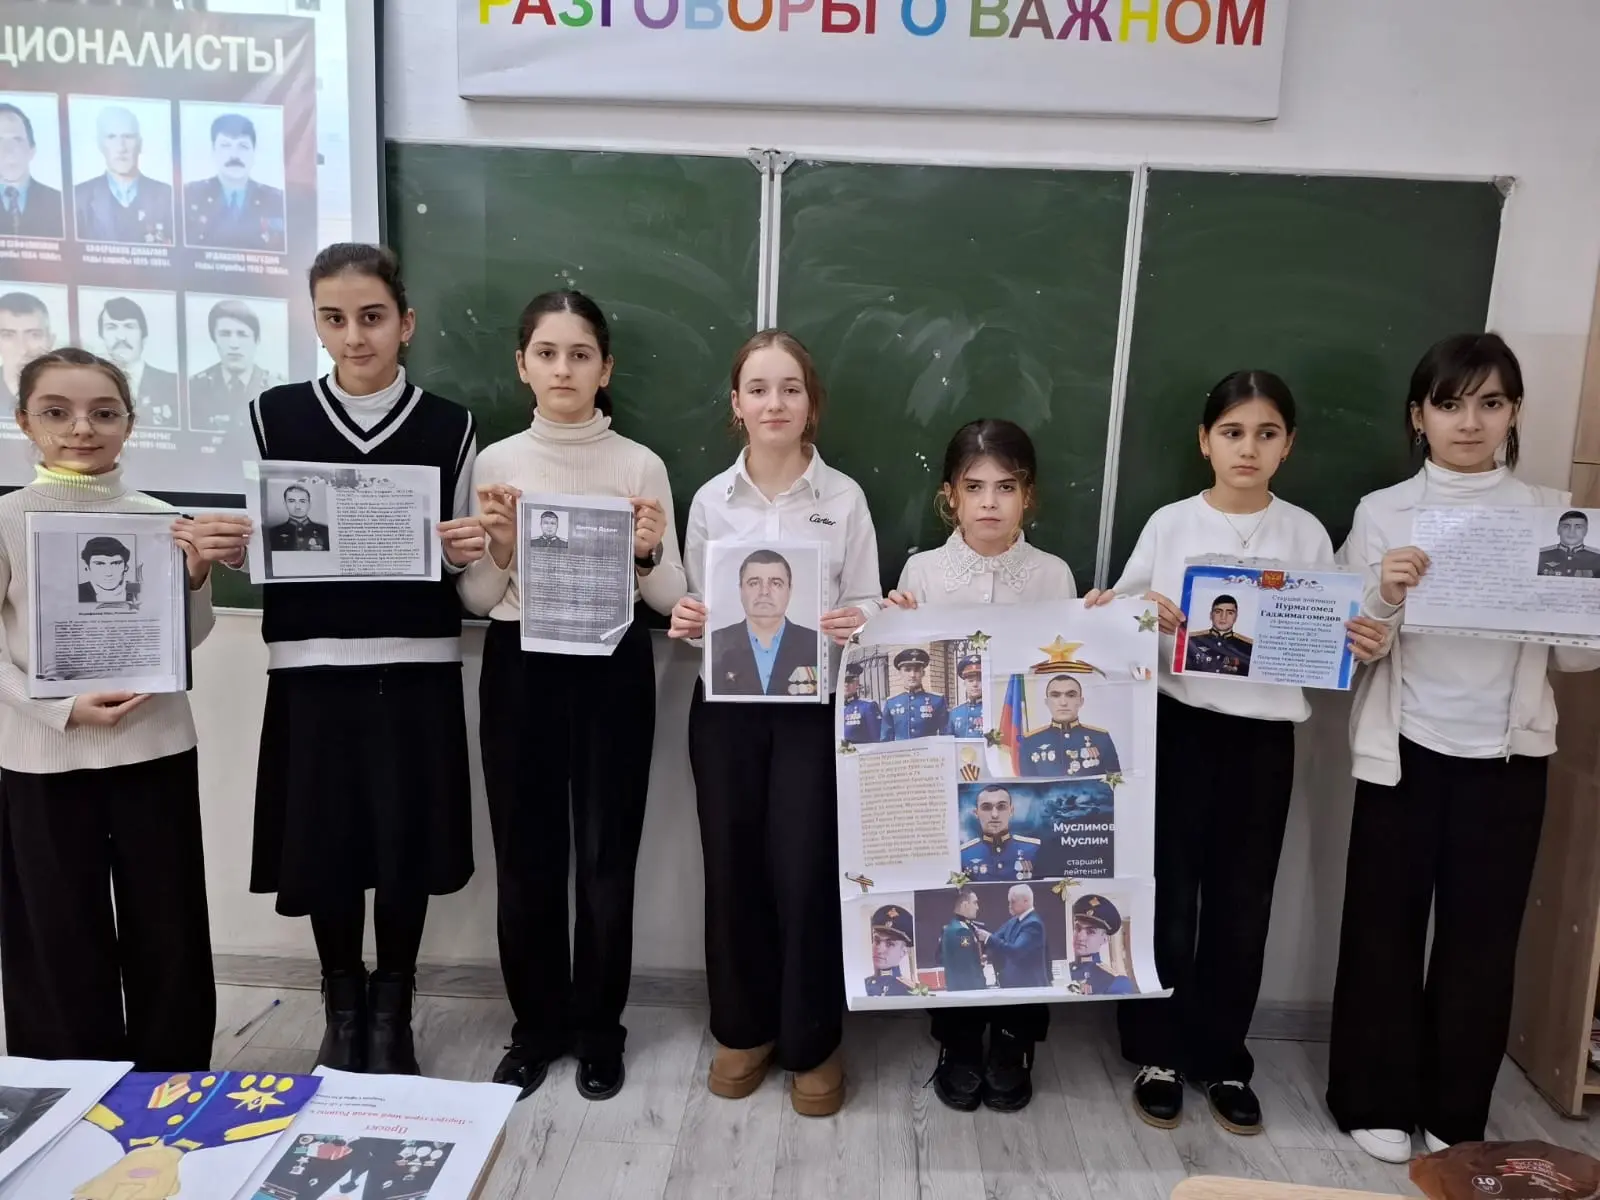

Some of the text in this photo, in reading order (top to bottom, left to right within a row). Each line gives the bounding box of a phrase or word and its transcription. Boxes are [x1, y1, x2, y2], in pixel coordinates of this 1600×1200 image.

[901, 0, 947, 37] О
[969, 0, 1265, 46] ВАЖНОМ
[809, 513, 836, 526] Cartier
[1275, 602, 1334, 613] Нурмагомед
[1260, 610, 1342, 622] Гаджимагомедов
[1053, 822, 1117, 834] Муслимов
[1061, 836, 1108, 848] Муслим
[1066, 857, 1103, 867] старший
[1063, 867, 1108, 876] лейтенант
